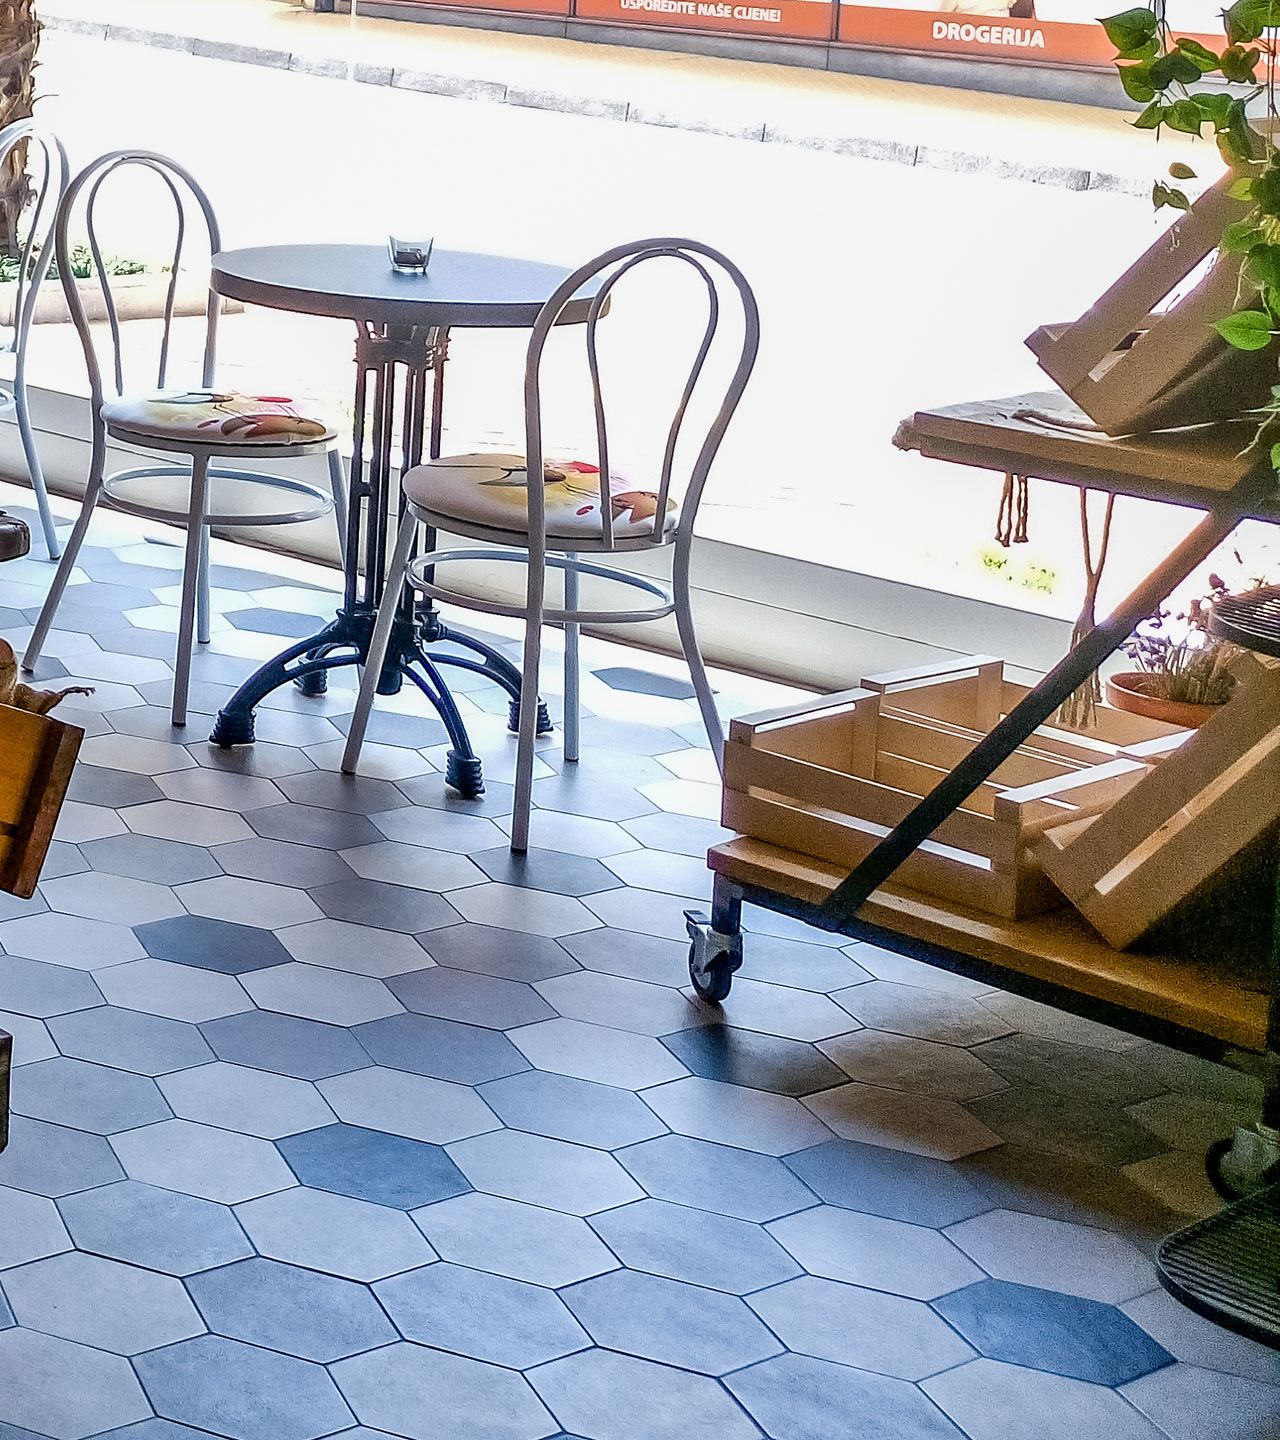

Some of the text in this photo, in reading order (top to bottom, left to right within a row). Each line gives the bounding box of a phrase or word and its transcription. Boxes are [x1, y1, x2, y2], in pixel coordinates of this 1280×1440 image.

[697, 1, 732, 19] NAŠE
[733, 4, 782, 23] CIJENE!
[931, 21, 1046, 49] DROGERIJA
